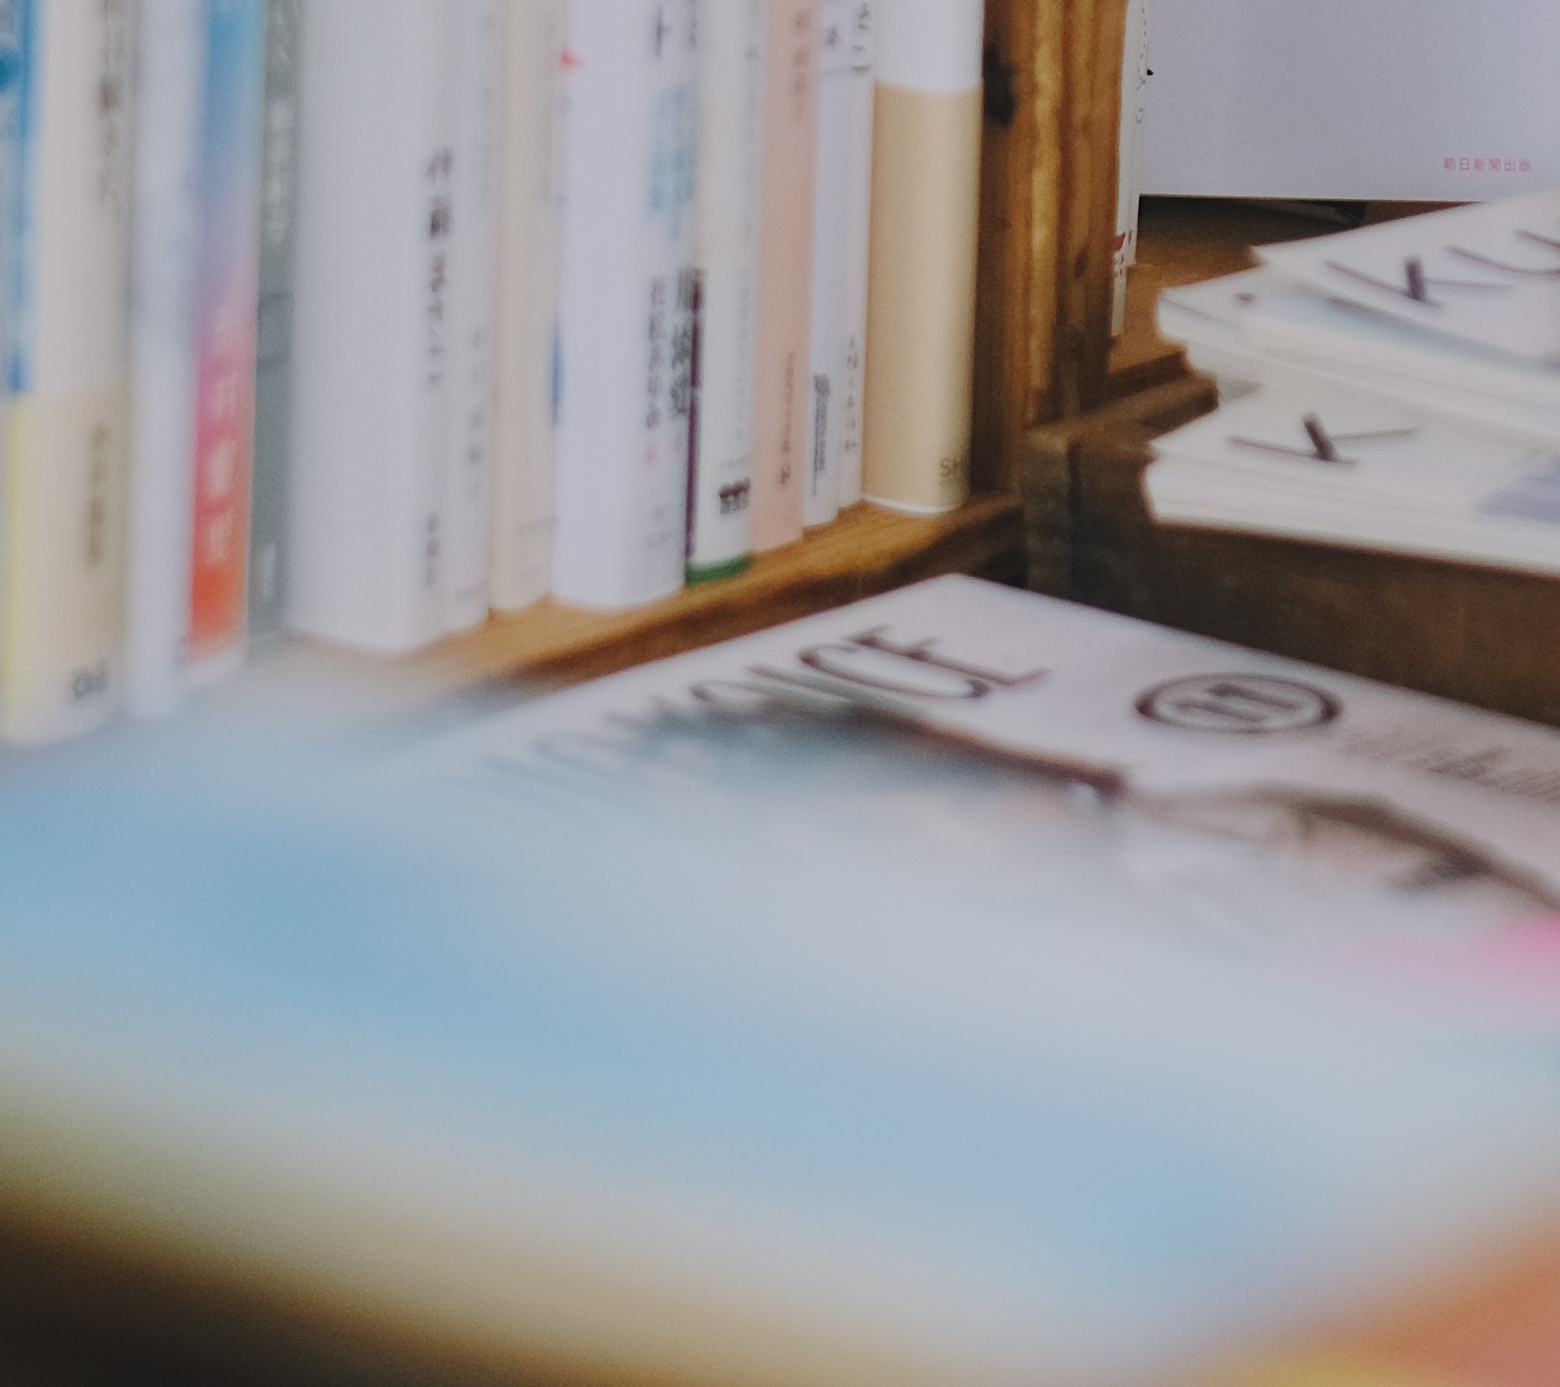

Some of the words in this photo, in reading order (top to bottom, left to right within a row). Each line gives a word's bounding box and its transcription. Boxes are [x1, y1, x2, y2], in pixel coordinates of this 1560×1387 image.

[1443, 157, 1533, 173] 朝日新聞出版
